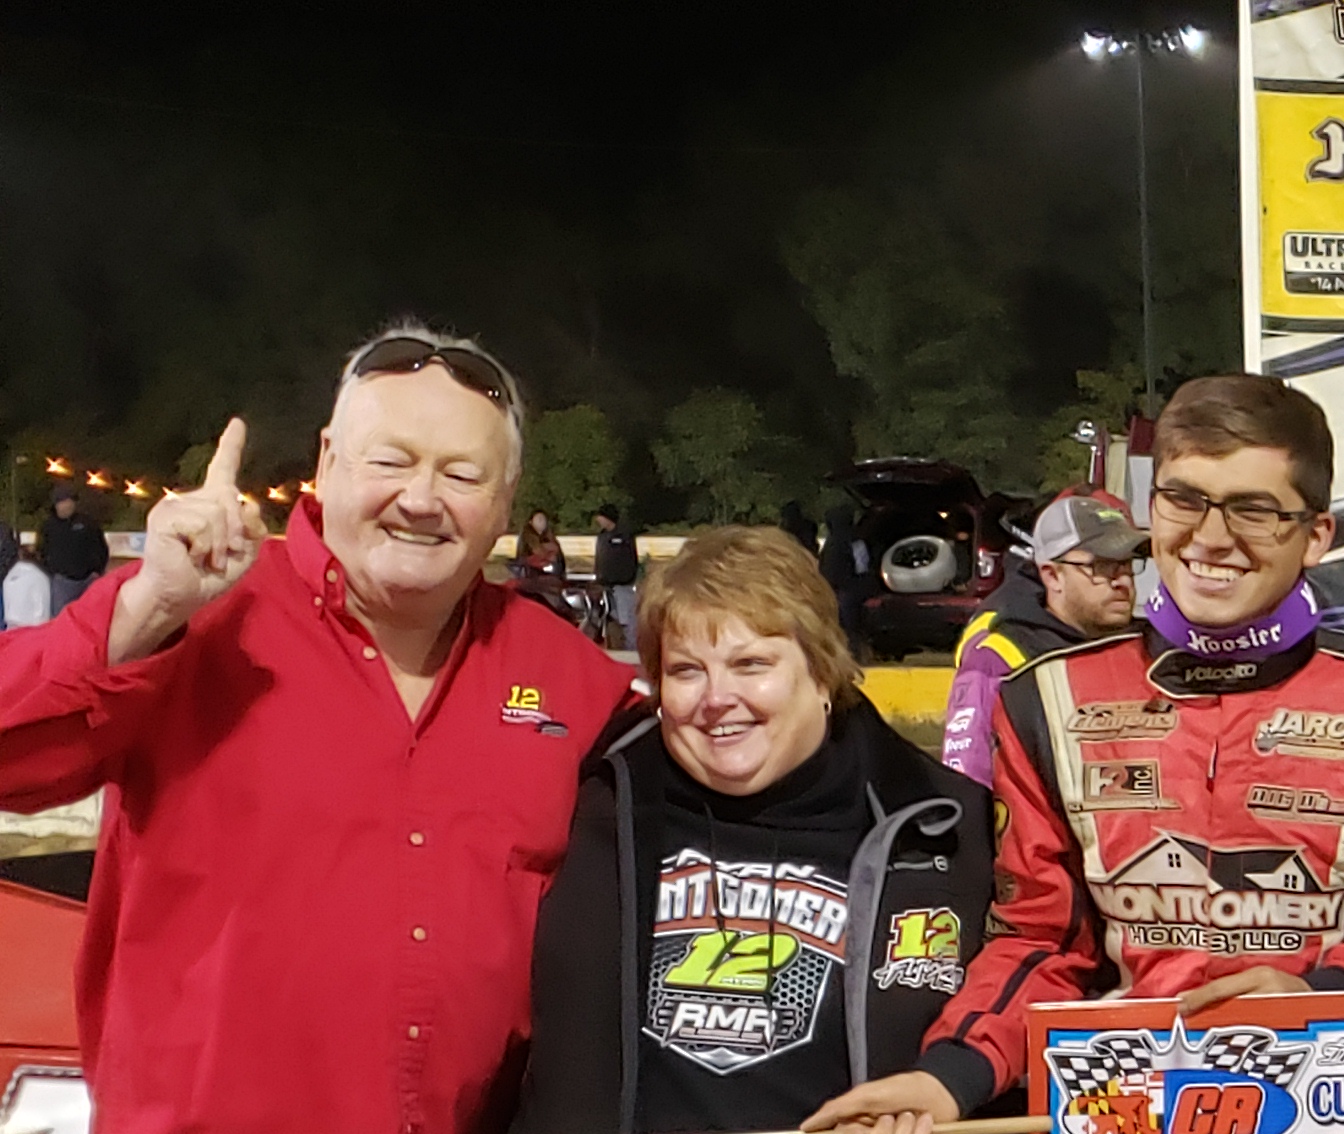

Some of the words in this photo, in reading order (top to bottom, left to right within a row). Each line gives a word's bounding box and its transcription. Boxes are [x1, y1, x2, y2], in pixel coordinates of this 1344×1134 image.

[1187, 623, 1282, 654] Hoosier
[505, 684, 541, 710] 12
[656, 870, 848, 945] NTGOMER
[889, 907, 961, 961] 12
[1243, 931, 1302, 951] LLC
[664, 930, 801, 993] 12
